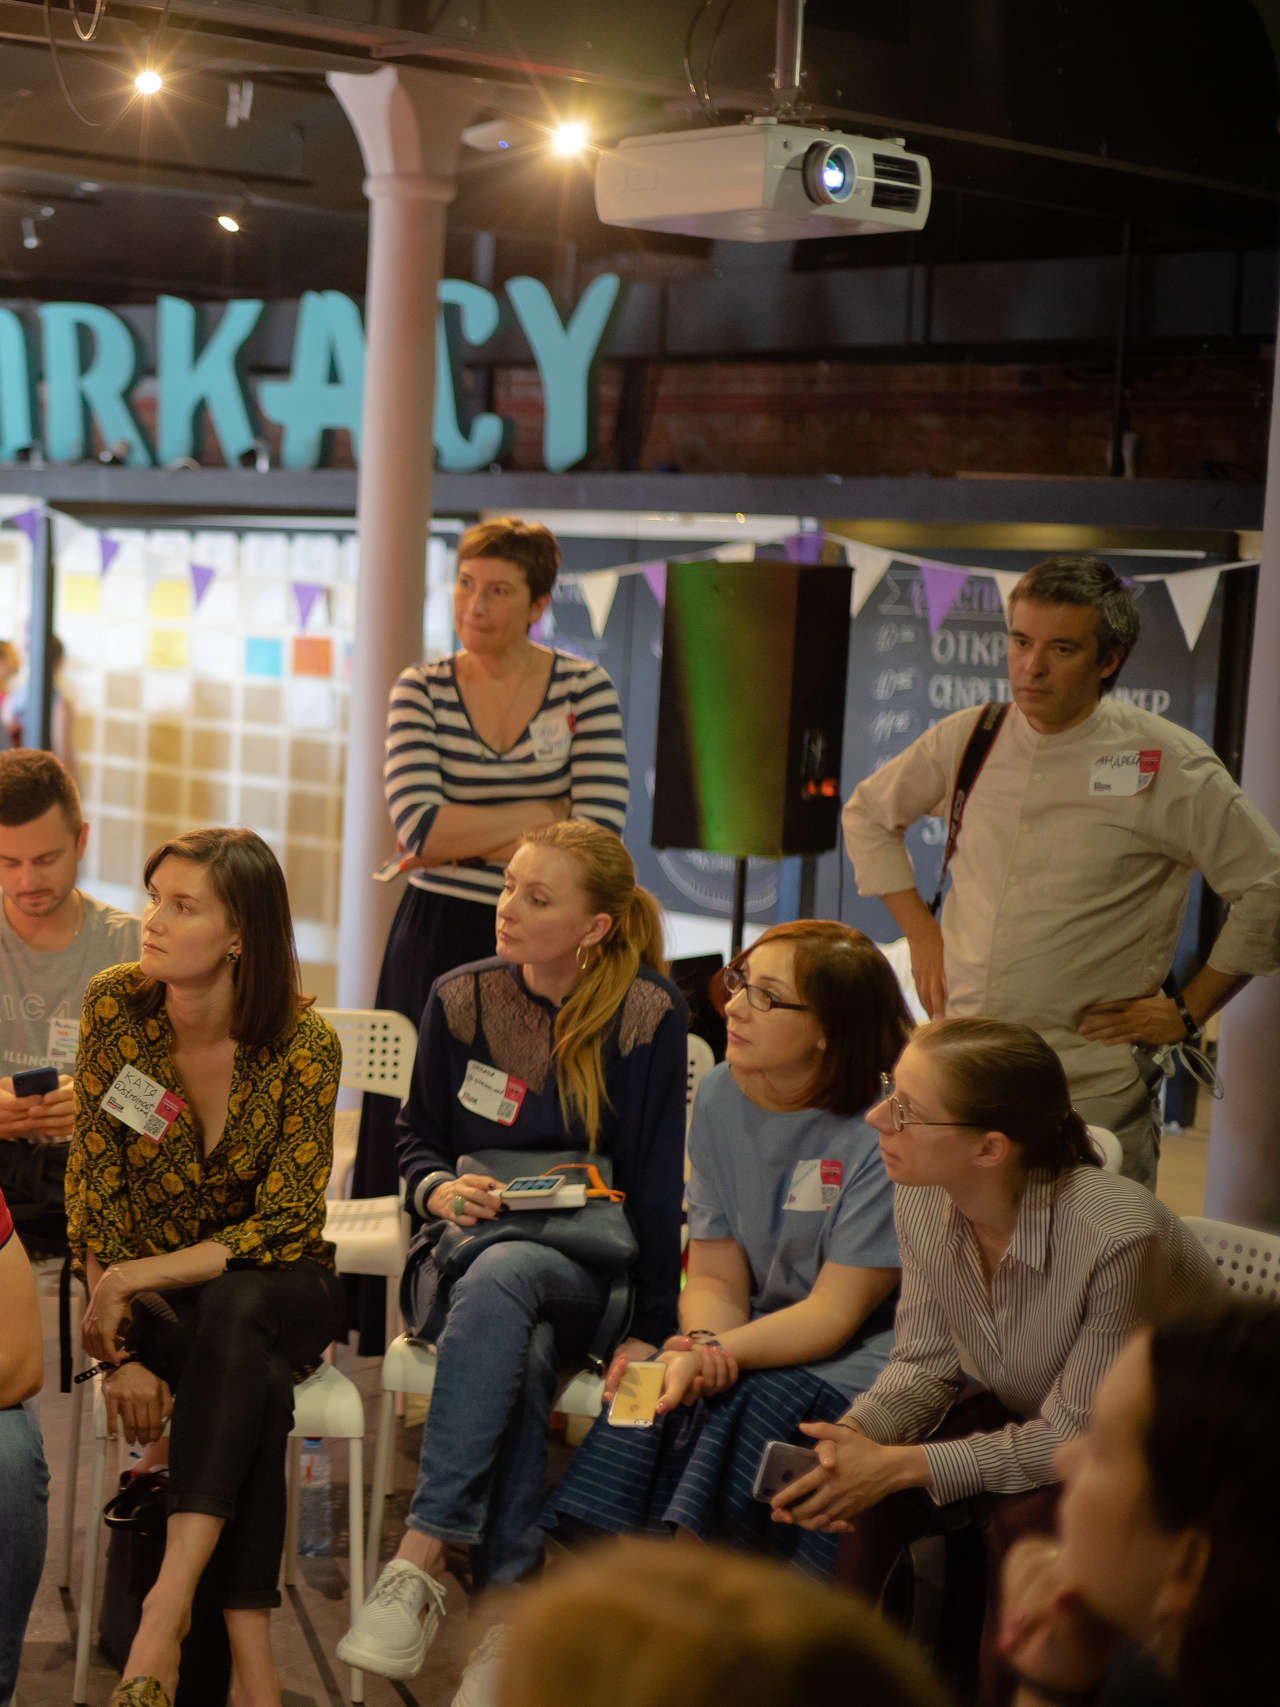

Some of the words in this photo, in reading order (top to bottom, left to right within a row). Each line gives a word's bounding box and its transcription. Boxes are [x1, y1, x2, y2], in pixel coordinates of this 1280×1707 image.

[1095, 752, 1144, 769] АНДРЕЙ
[3, 1049, 64, 1070] ILLINOIS
[124, 1071, 158, 1098] КАТЯ
